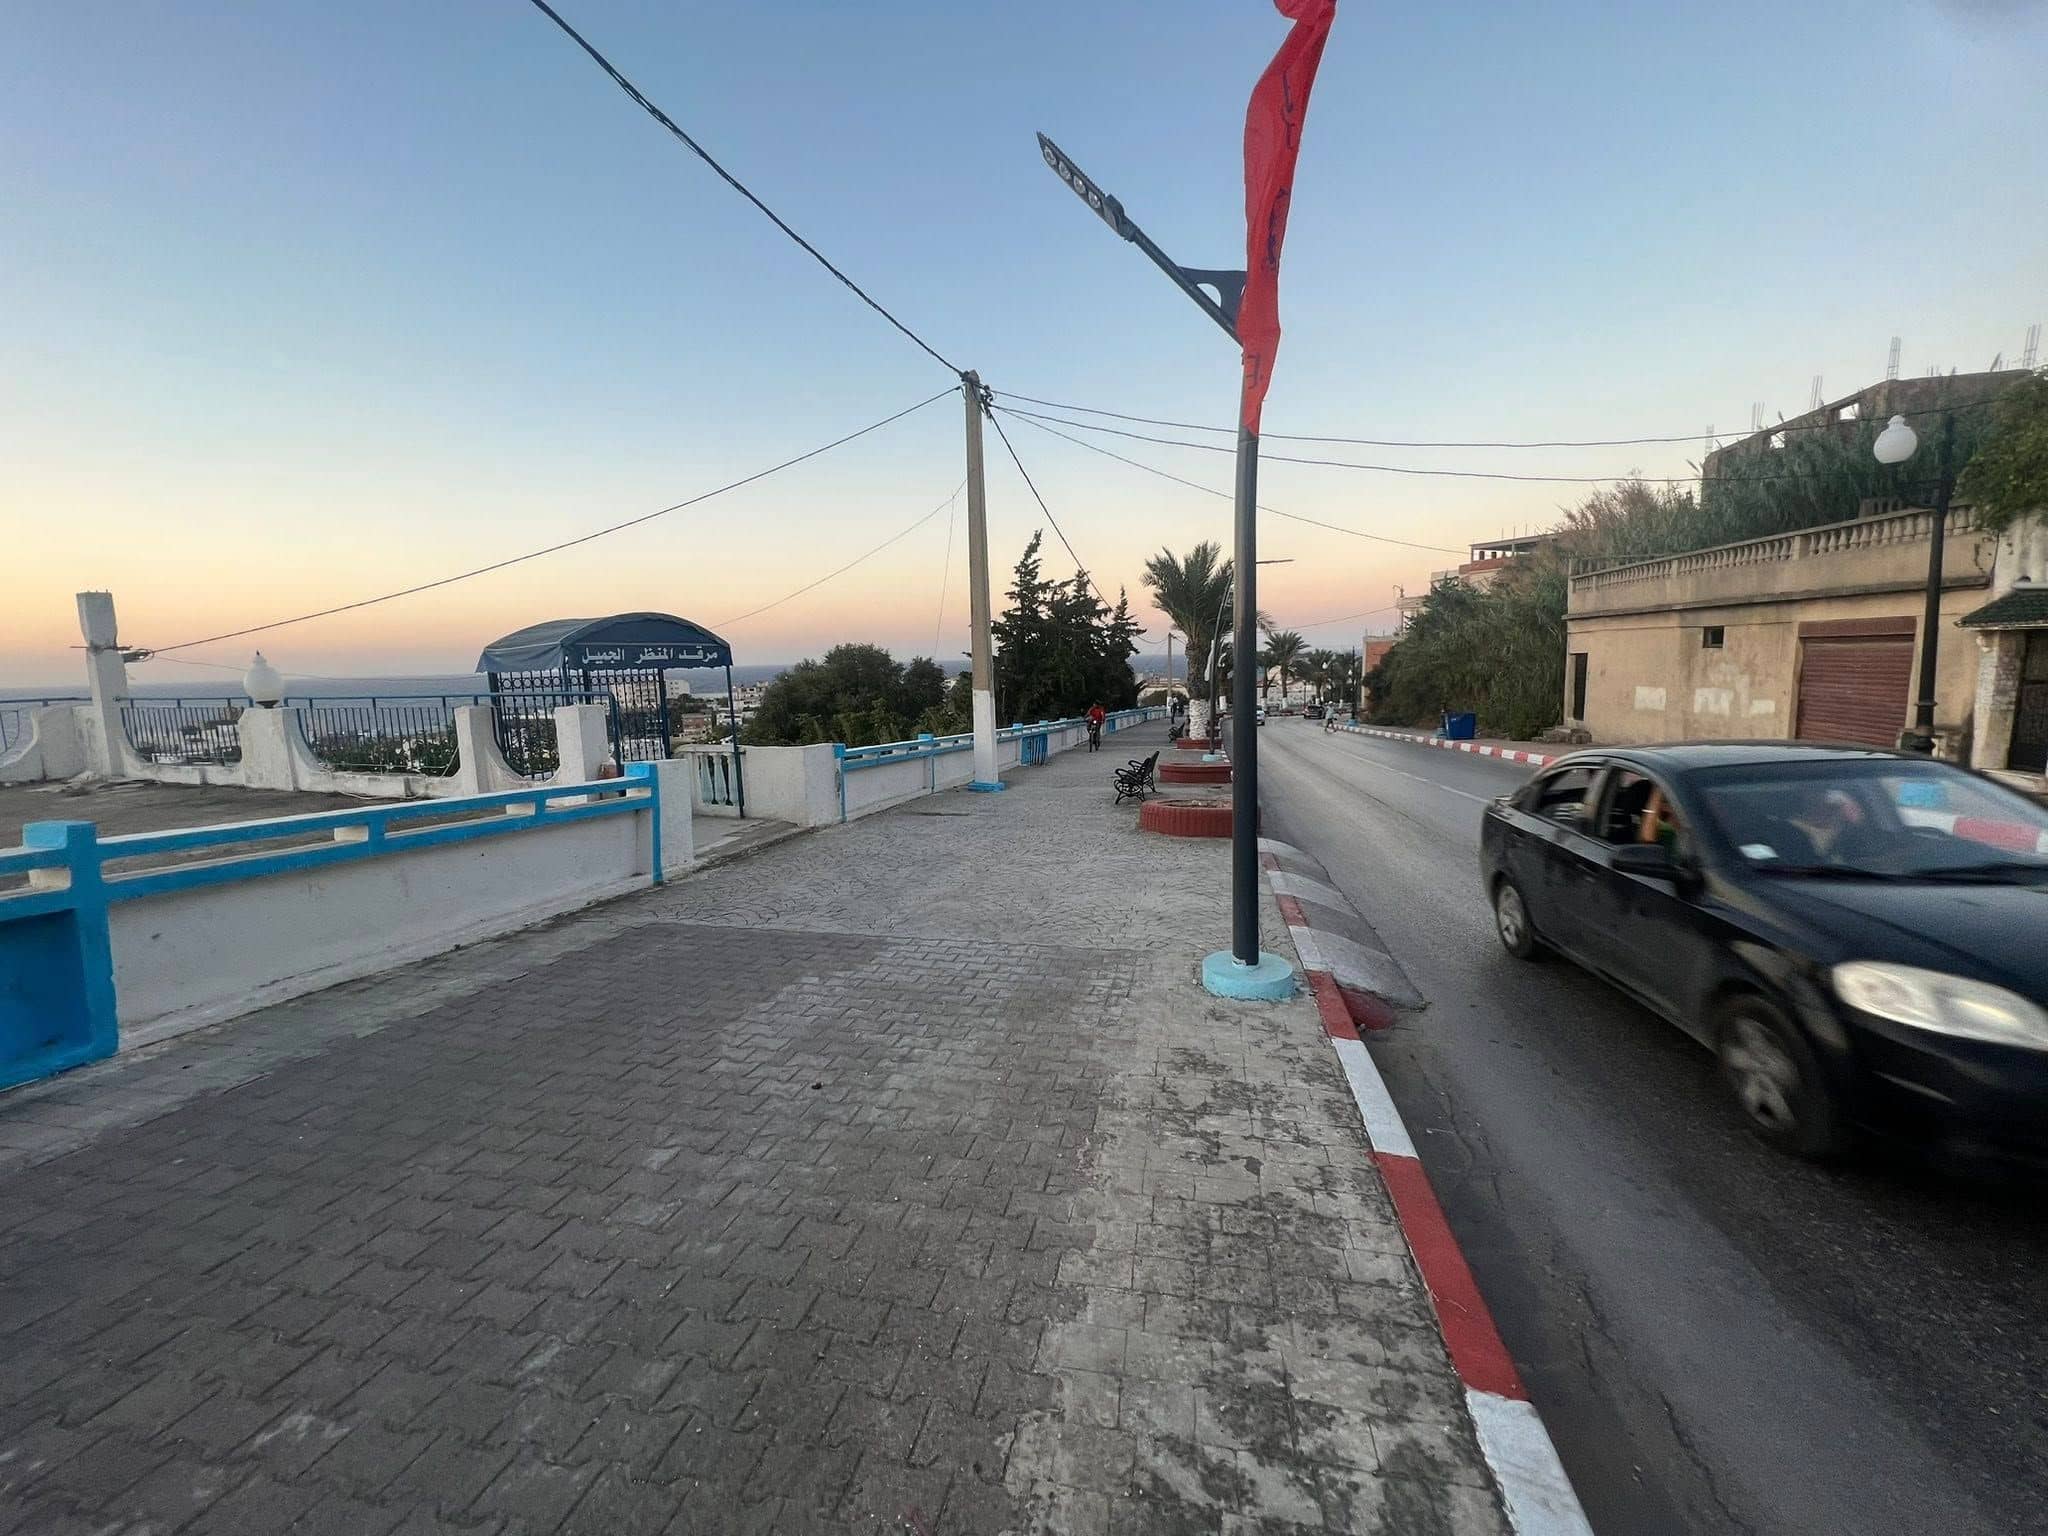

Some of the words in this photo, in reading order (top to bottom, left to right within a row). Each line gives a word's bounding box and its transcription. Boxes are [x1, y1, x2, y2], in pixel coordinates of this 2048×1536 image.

[582, 647, 625, 664] الجميل
[635, 647, 673, 664] المنظر
[679, 646, 718, 662] مرقد
